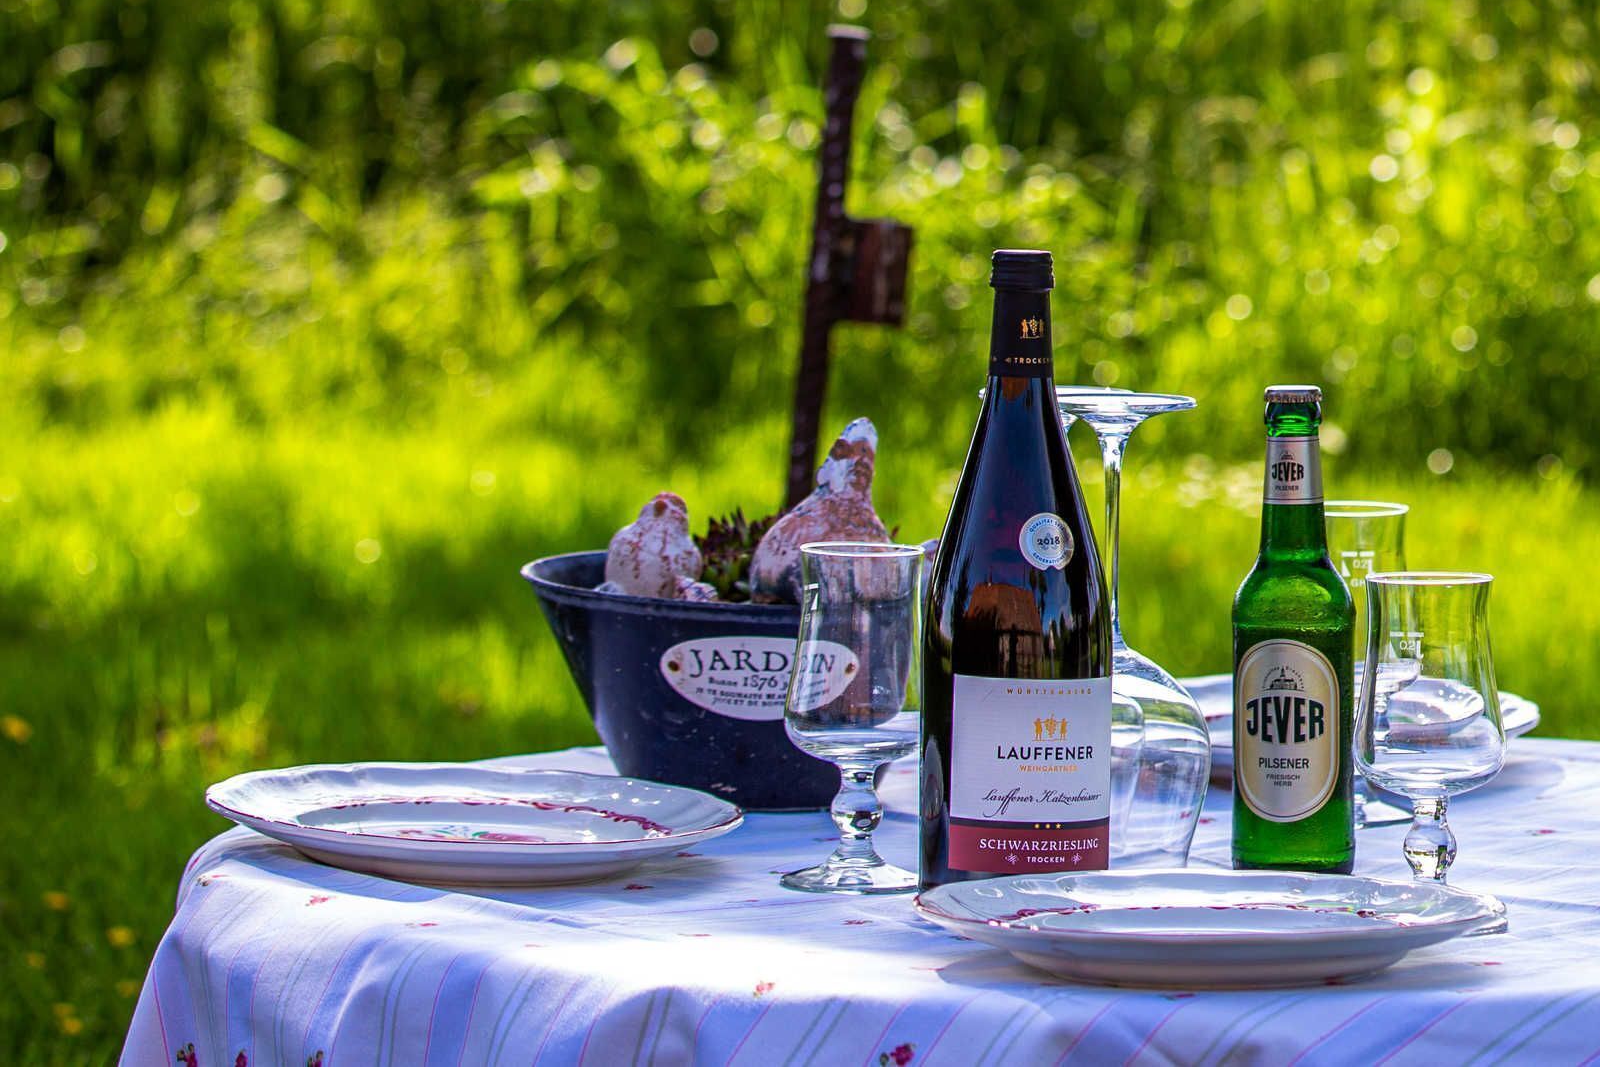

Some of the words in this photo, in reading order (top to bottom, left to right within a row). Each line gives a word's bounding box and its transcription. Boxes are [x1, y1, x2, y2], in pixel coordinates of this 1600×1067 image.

[1272, 462, 1304, 481] JEVER
[1037, 536, 1060, 545] 2018
[743, 674, 778, 691] 1876
[1246, 696, 1325, 744] JEVER
[997, 745, 1093, 760] LAUFFENER
[1258, 757, 1309, 769] PILSENER
[1266, 773, 1301, 781] FRIESISCH
[982, 787, 1034, 818] Lauffener
[979, 838, 1099, 851] SCHWARZRIESLING
